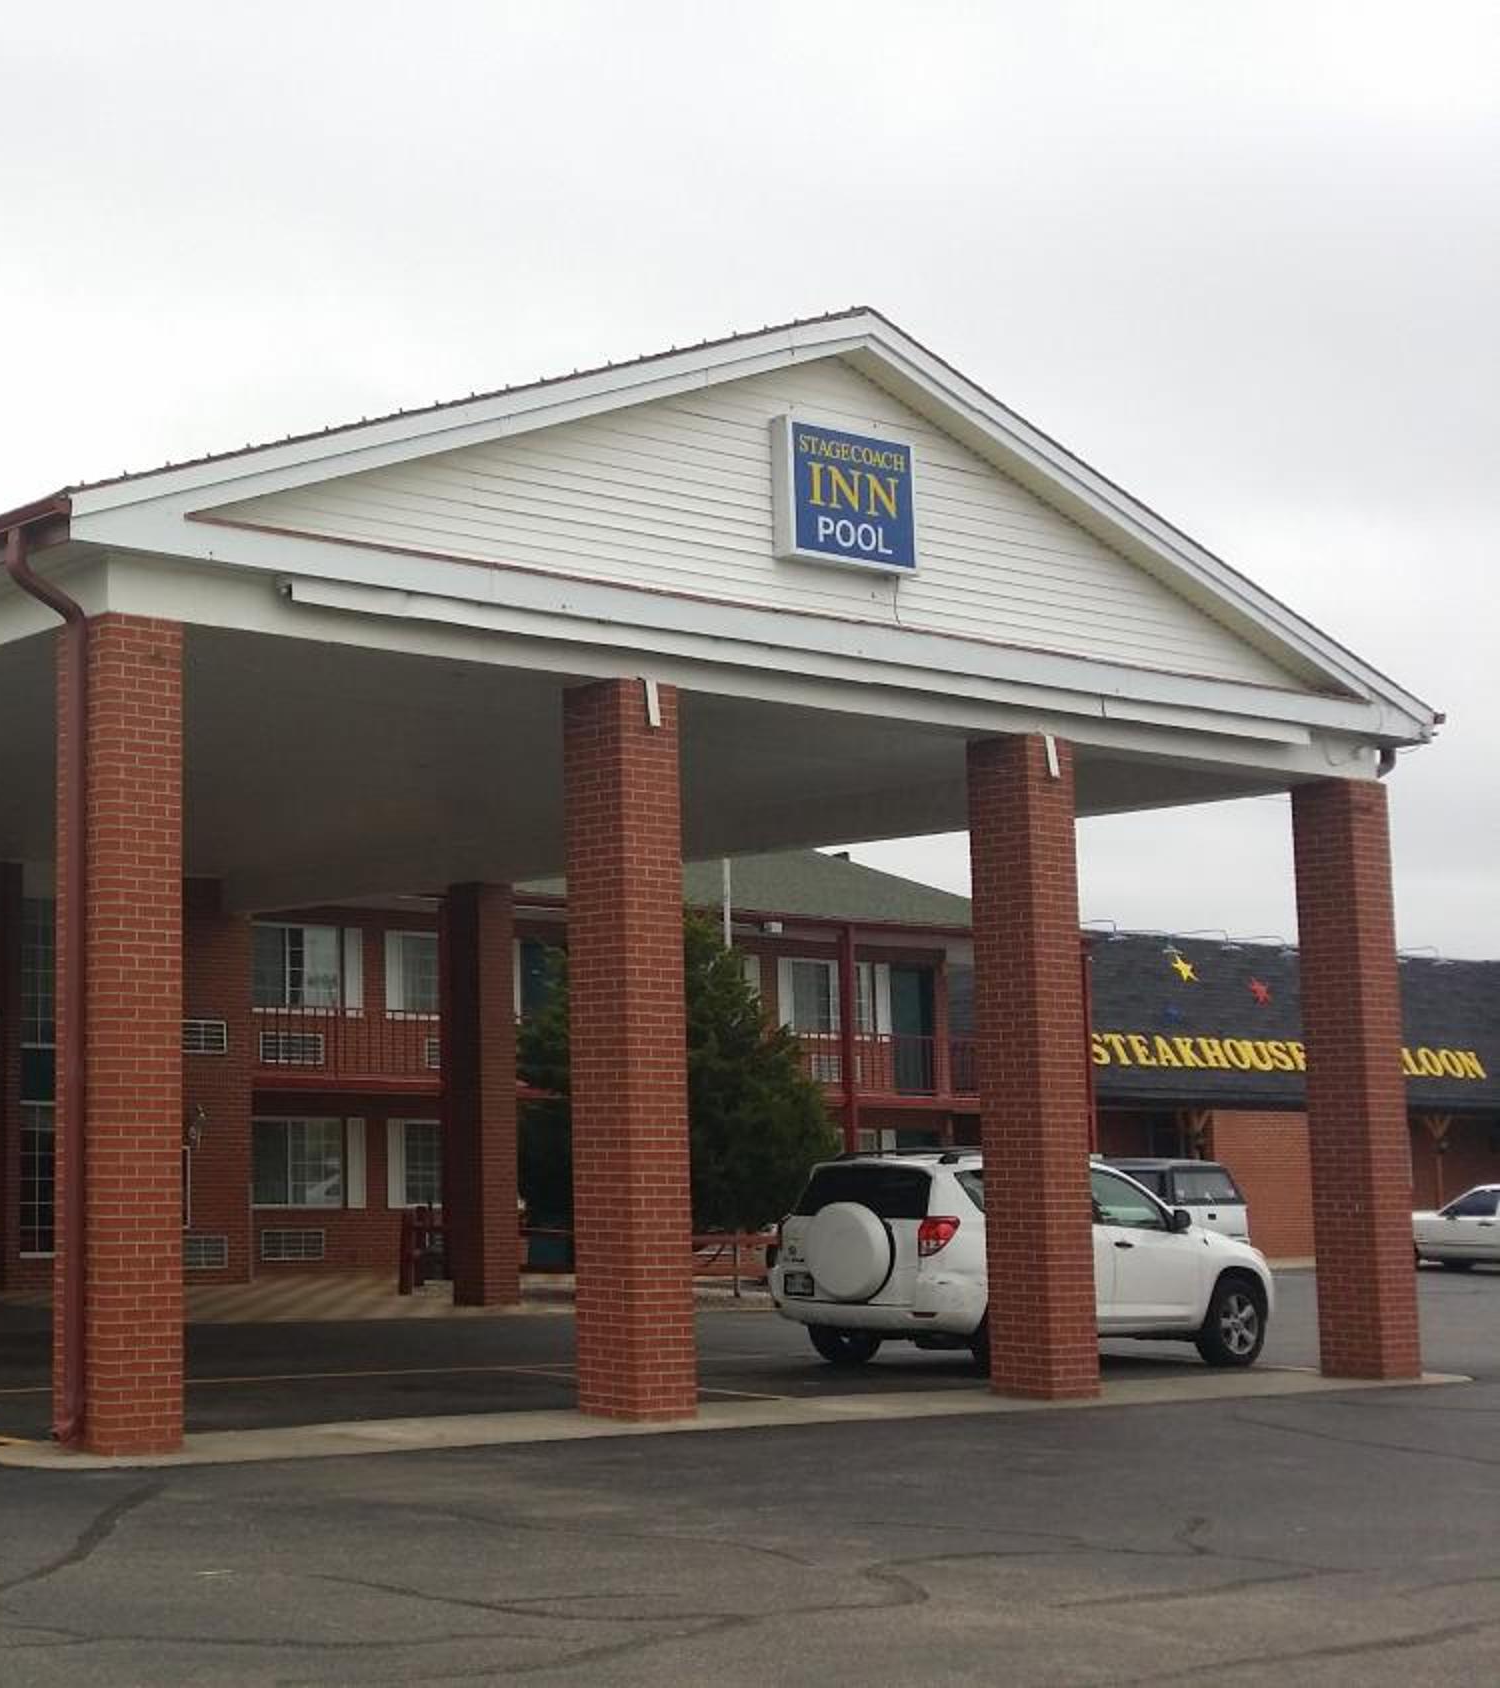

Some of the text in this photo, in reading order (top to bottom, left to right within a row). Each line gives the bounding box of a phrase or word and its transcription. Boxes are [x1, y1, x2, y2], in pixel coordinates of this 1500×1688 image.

[800, 435, 904, 472] STAGECOACH
[808, 462, 899, 518] INN
[818, 516, 893, 554] POOL
[1403, 1047, 1487, 1079] LOON
